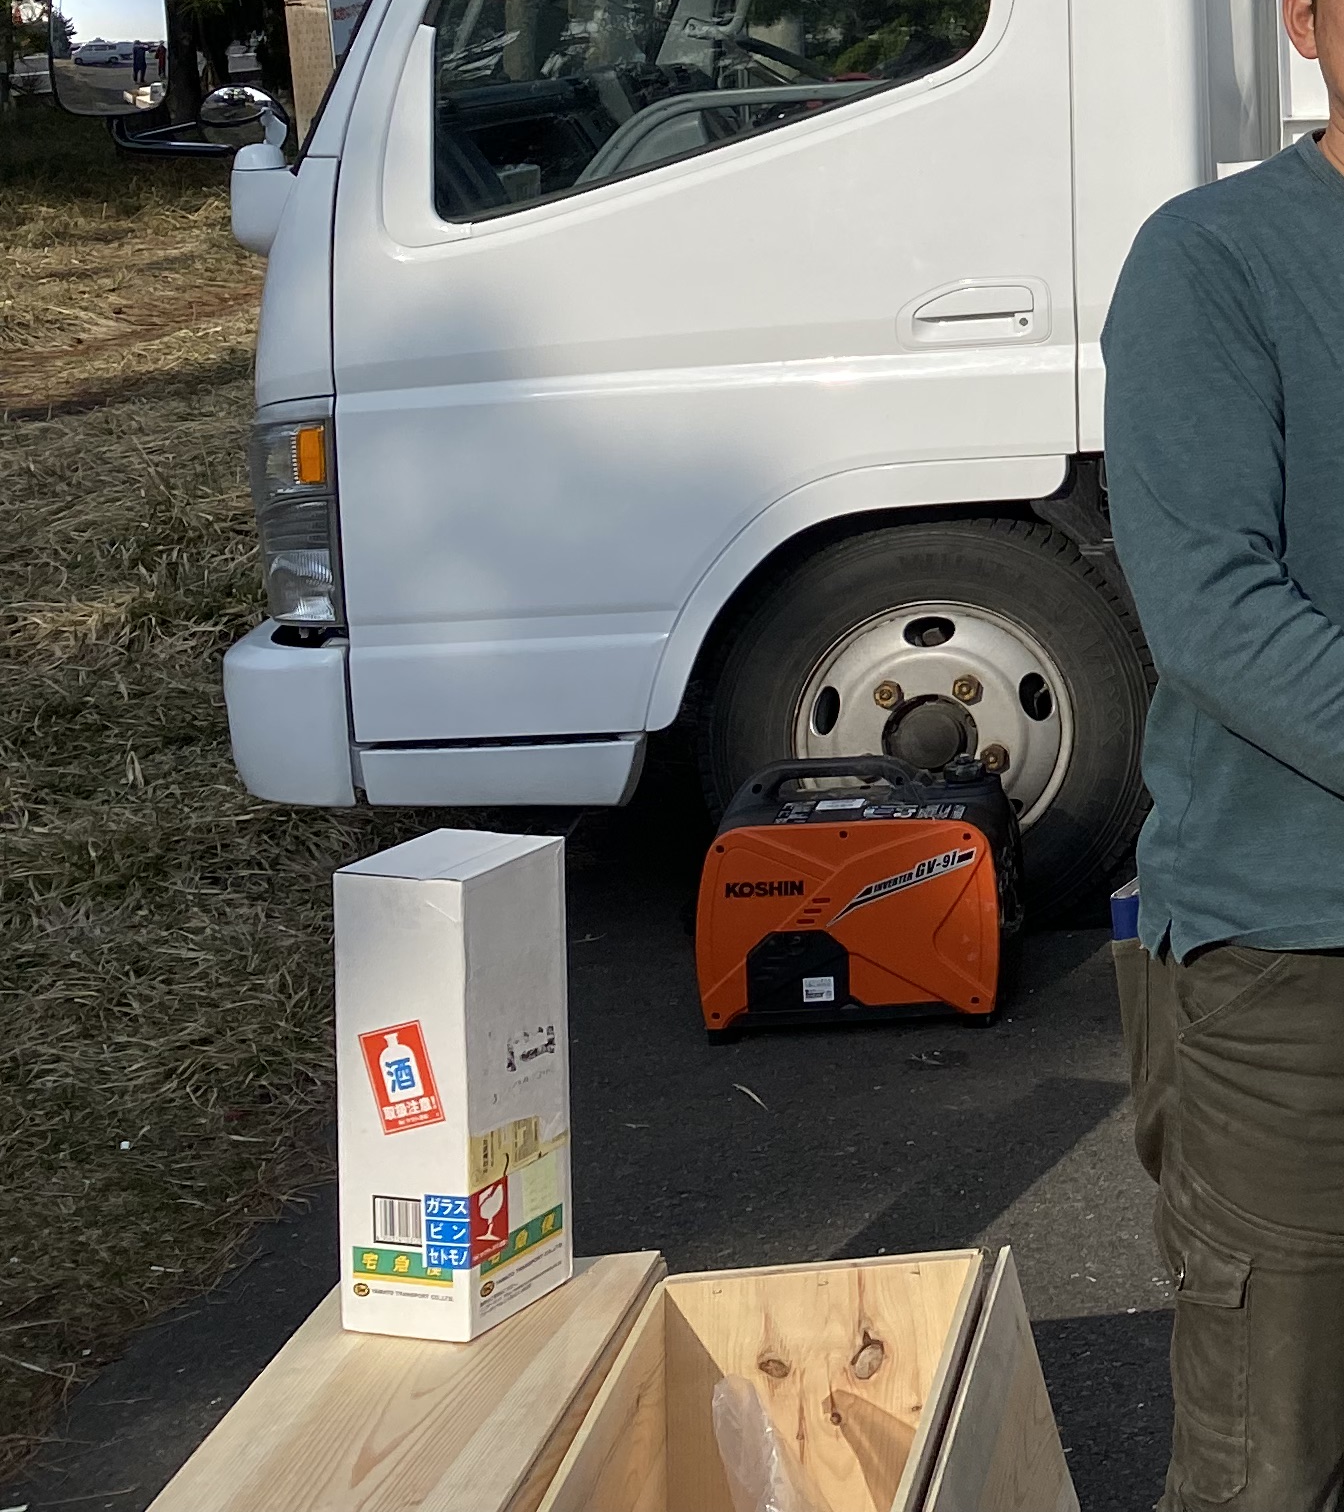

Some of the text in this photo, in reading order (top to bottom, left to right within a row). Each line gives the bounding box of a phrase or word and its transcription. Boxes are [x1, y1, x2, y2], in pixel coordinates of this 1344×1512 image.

[725, 880, 805, 899] KOSHIN
[385, 1057, 416, 1093] 酒
[426, 1198, 468, 1216] ガラス
[430, 1223, 467, 1240] ビン
[428, 1249, 468, 1267] セトモノ
